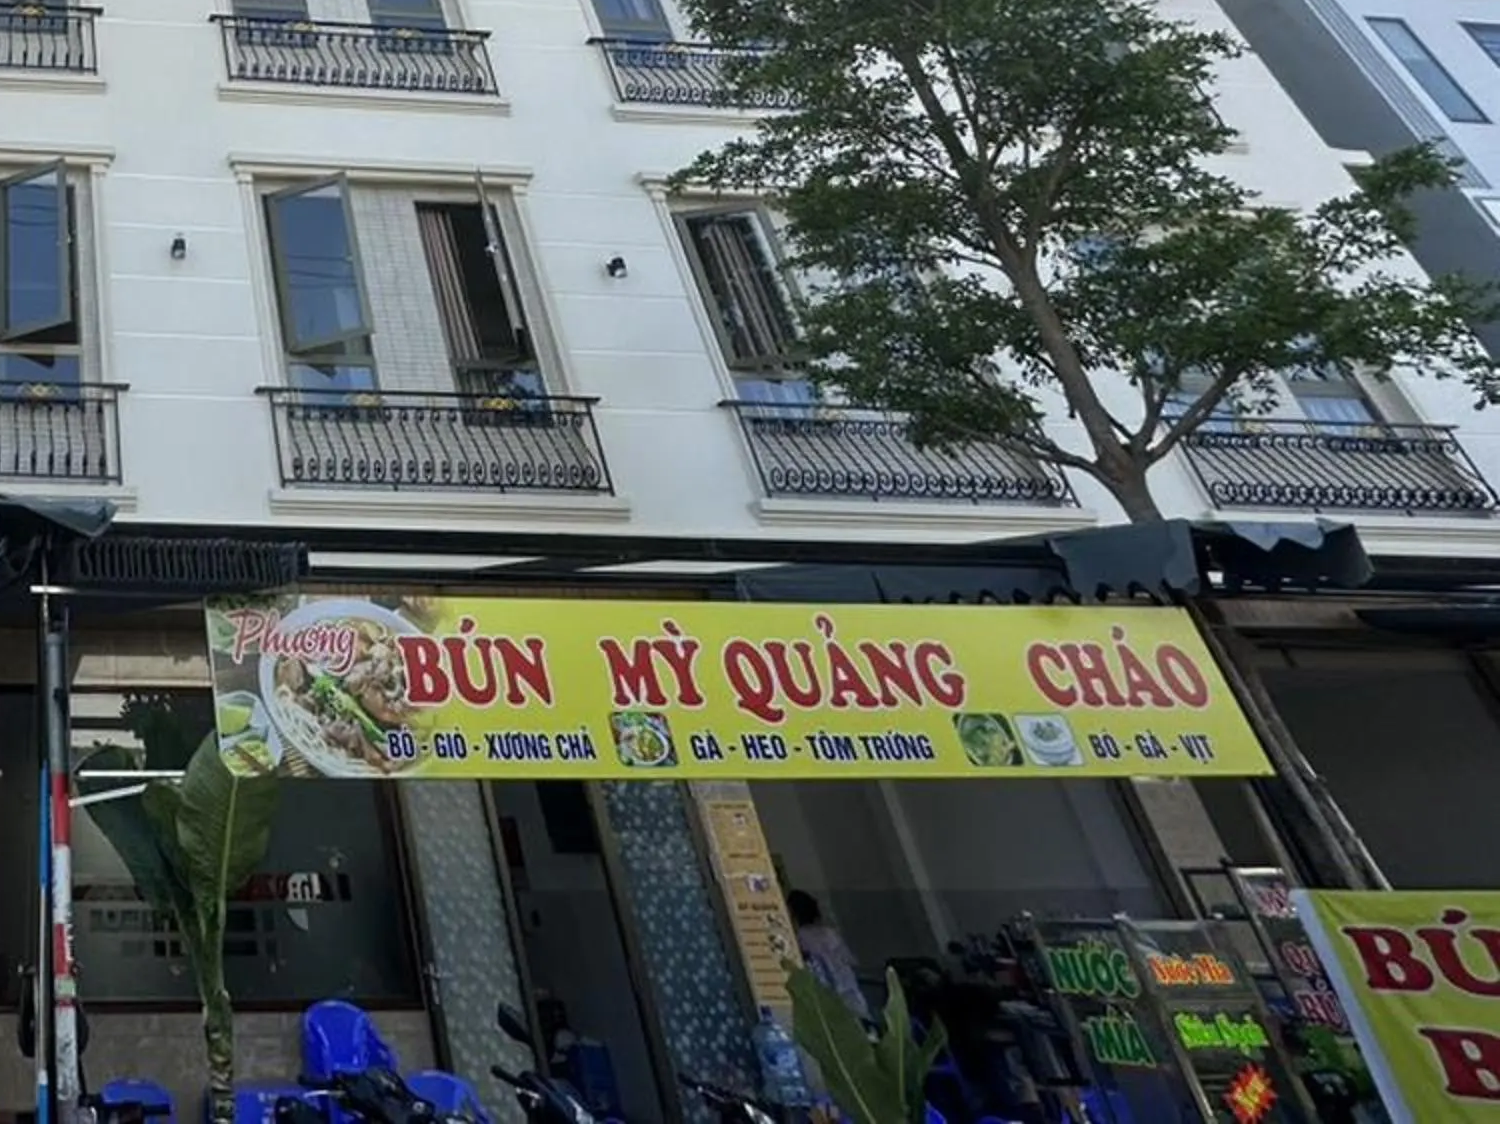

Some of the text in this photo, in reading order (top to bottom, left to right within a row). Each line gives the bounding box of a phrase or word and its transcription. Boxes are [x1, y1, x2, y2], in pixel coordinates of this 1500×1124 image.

[398, 616, 554, 707] BÚN
[599, 619, 705, 708] MỲ
[722, 613, 966, 723] QUẢNG
[689, 729, 724, 761] GÀ
[740, 733, 788, 761] HEO
[804, 730, 858, 761] TÔM
[858, 730, 935, 761] TRỨNG
